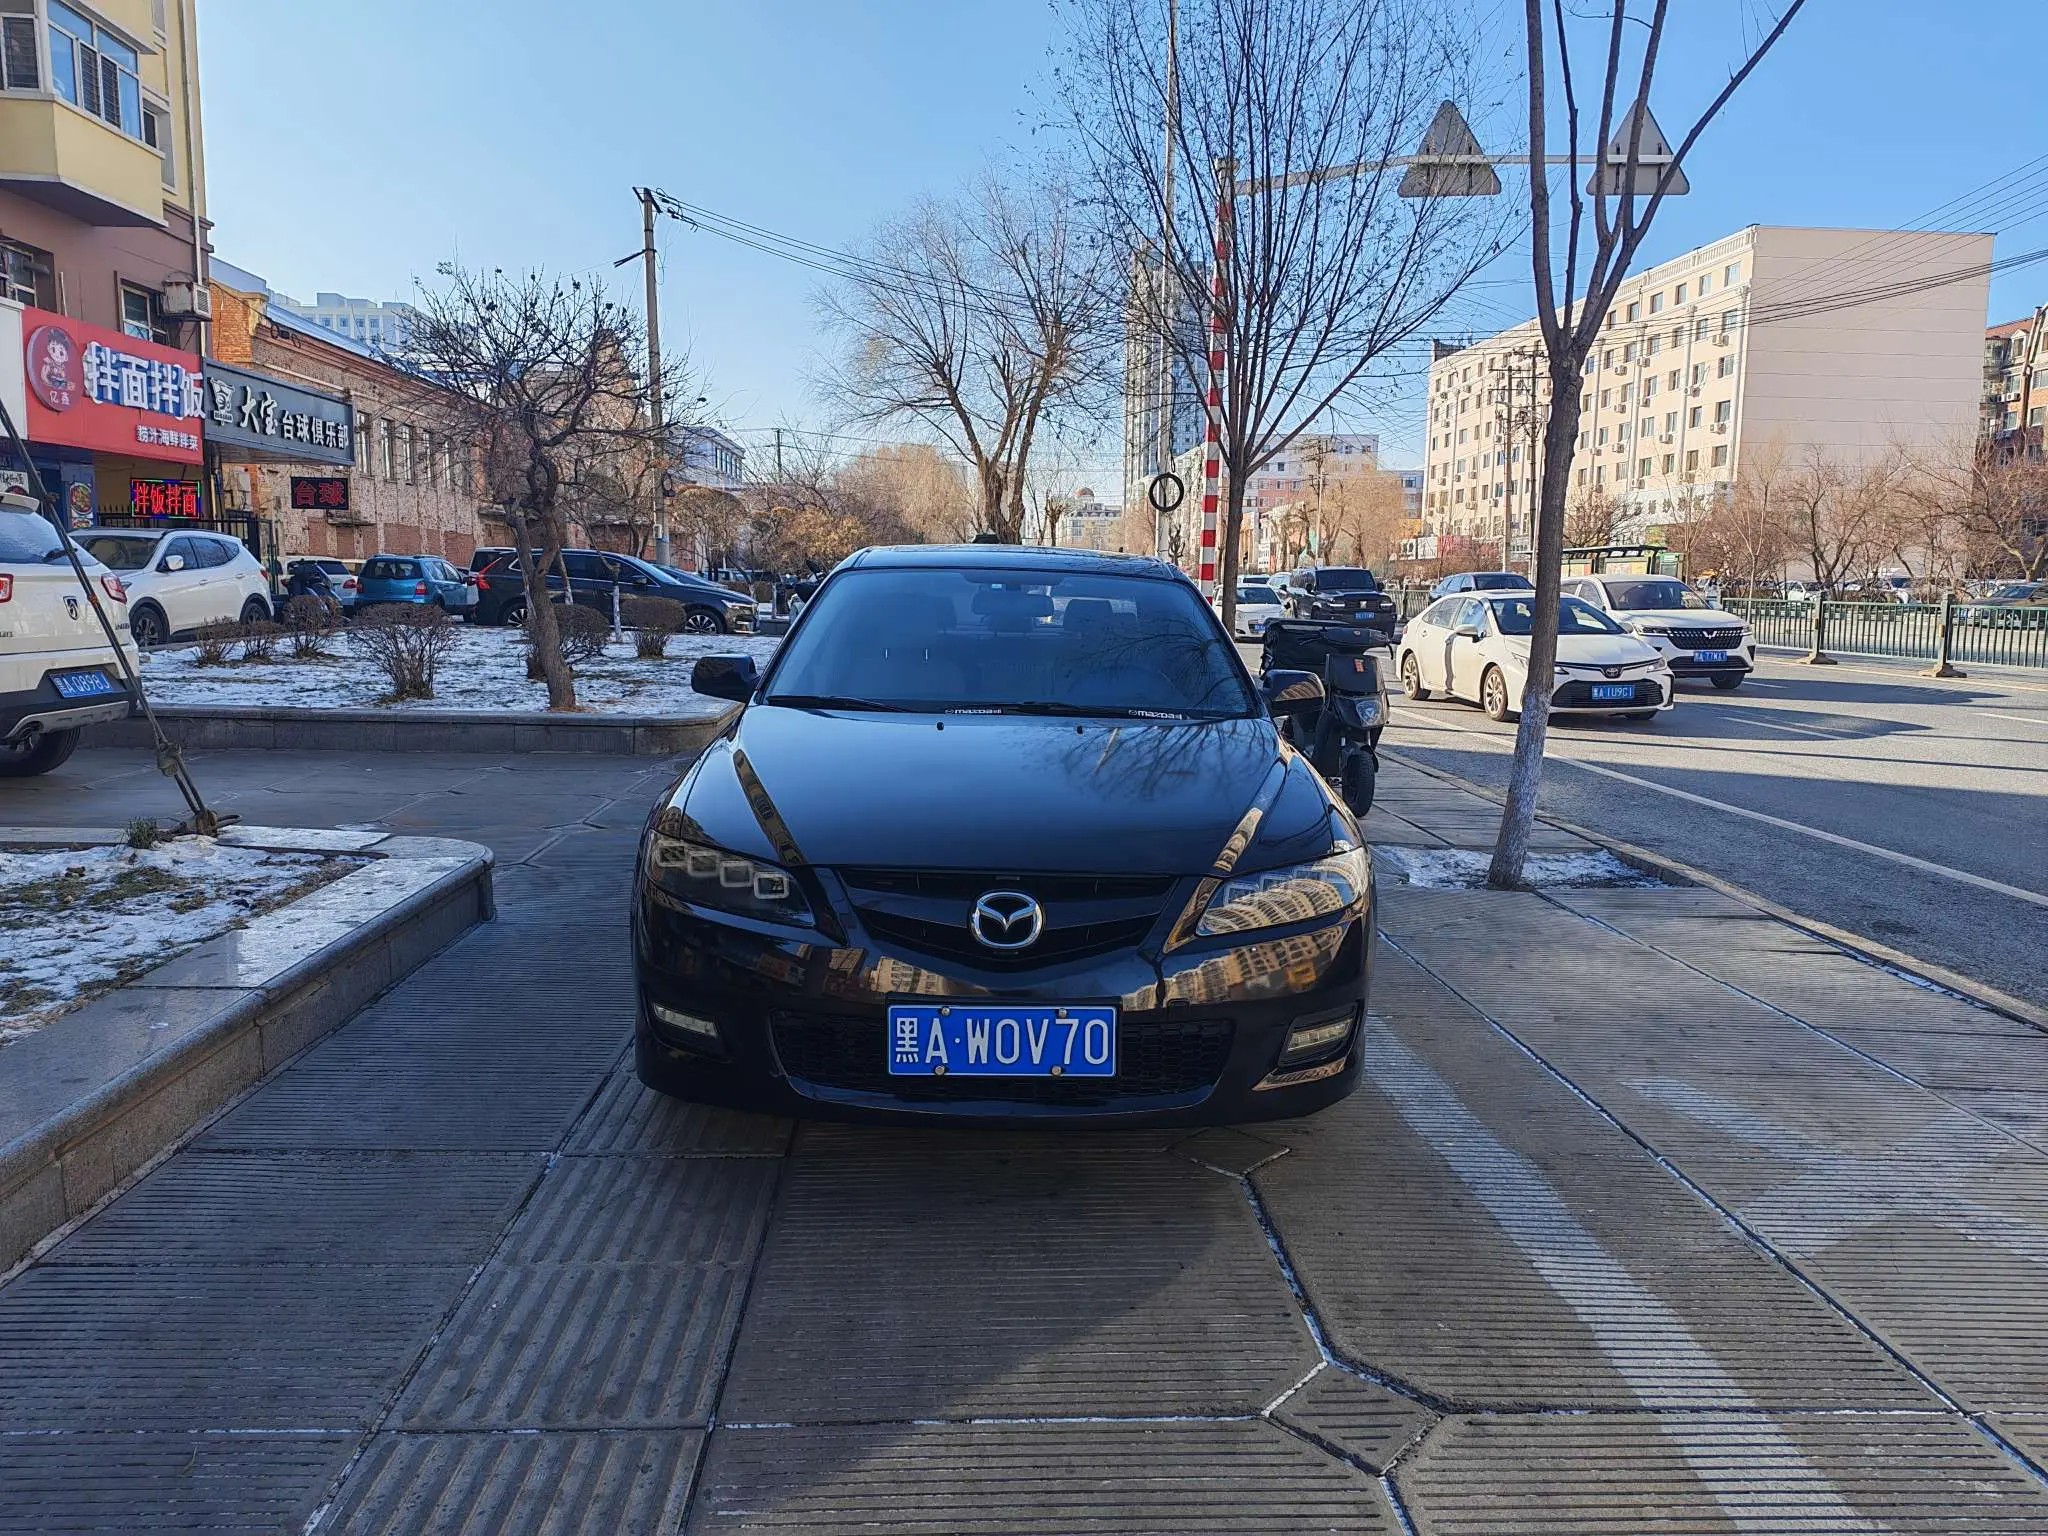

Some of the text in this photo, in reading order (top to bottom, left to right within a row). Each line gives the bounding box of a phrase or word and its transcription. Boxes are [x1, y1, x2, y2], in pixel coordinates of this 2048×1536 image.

[87, 342, 206, 419] 拌面拌饭
[133, 482, 197, 515] 拌饭拌面
[295, 480, 345, 506] 台球
